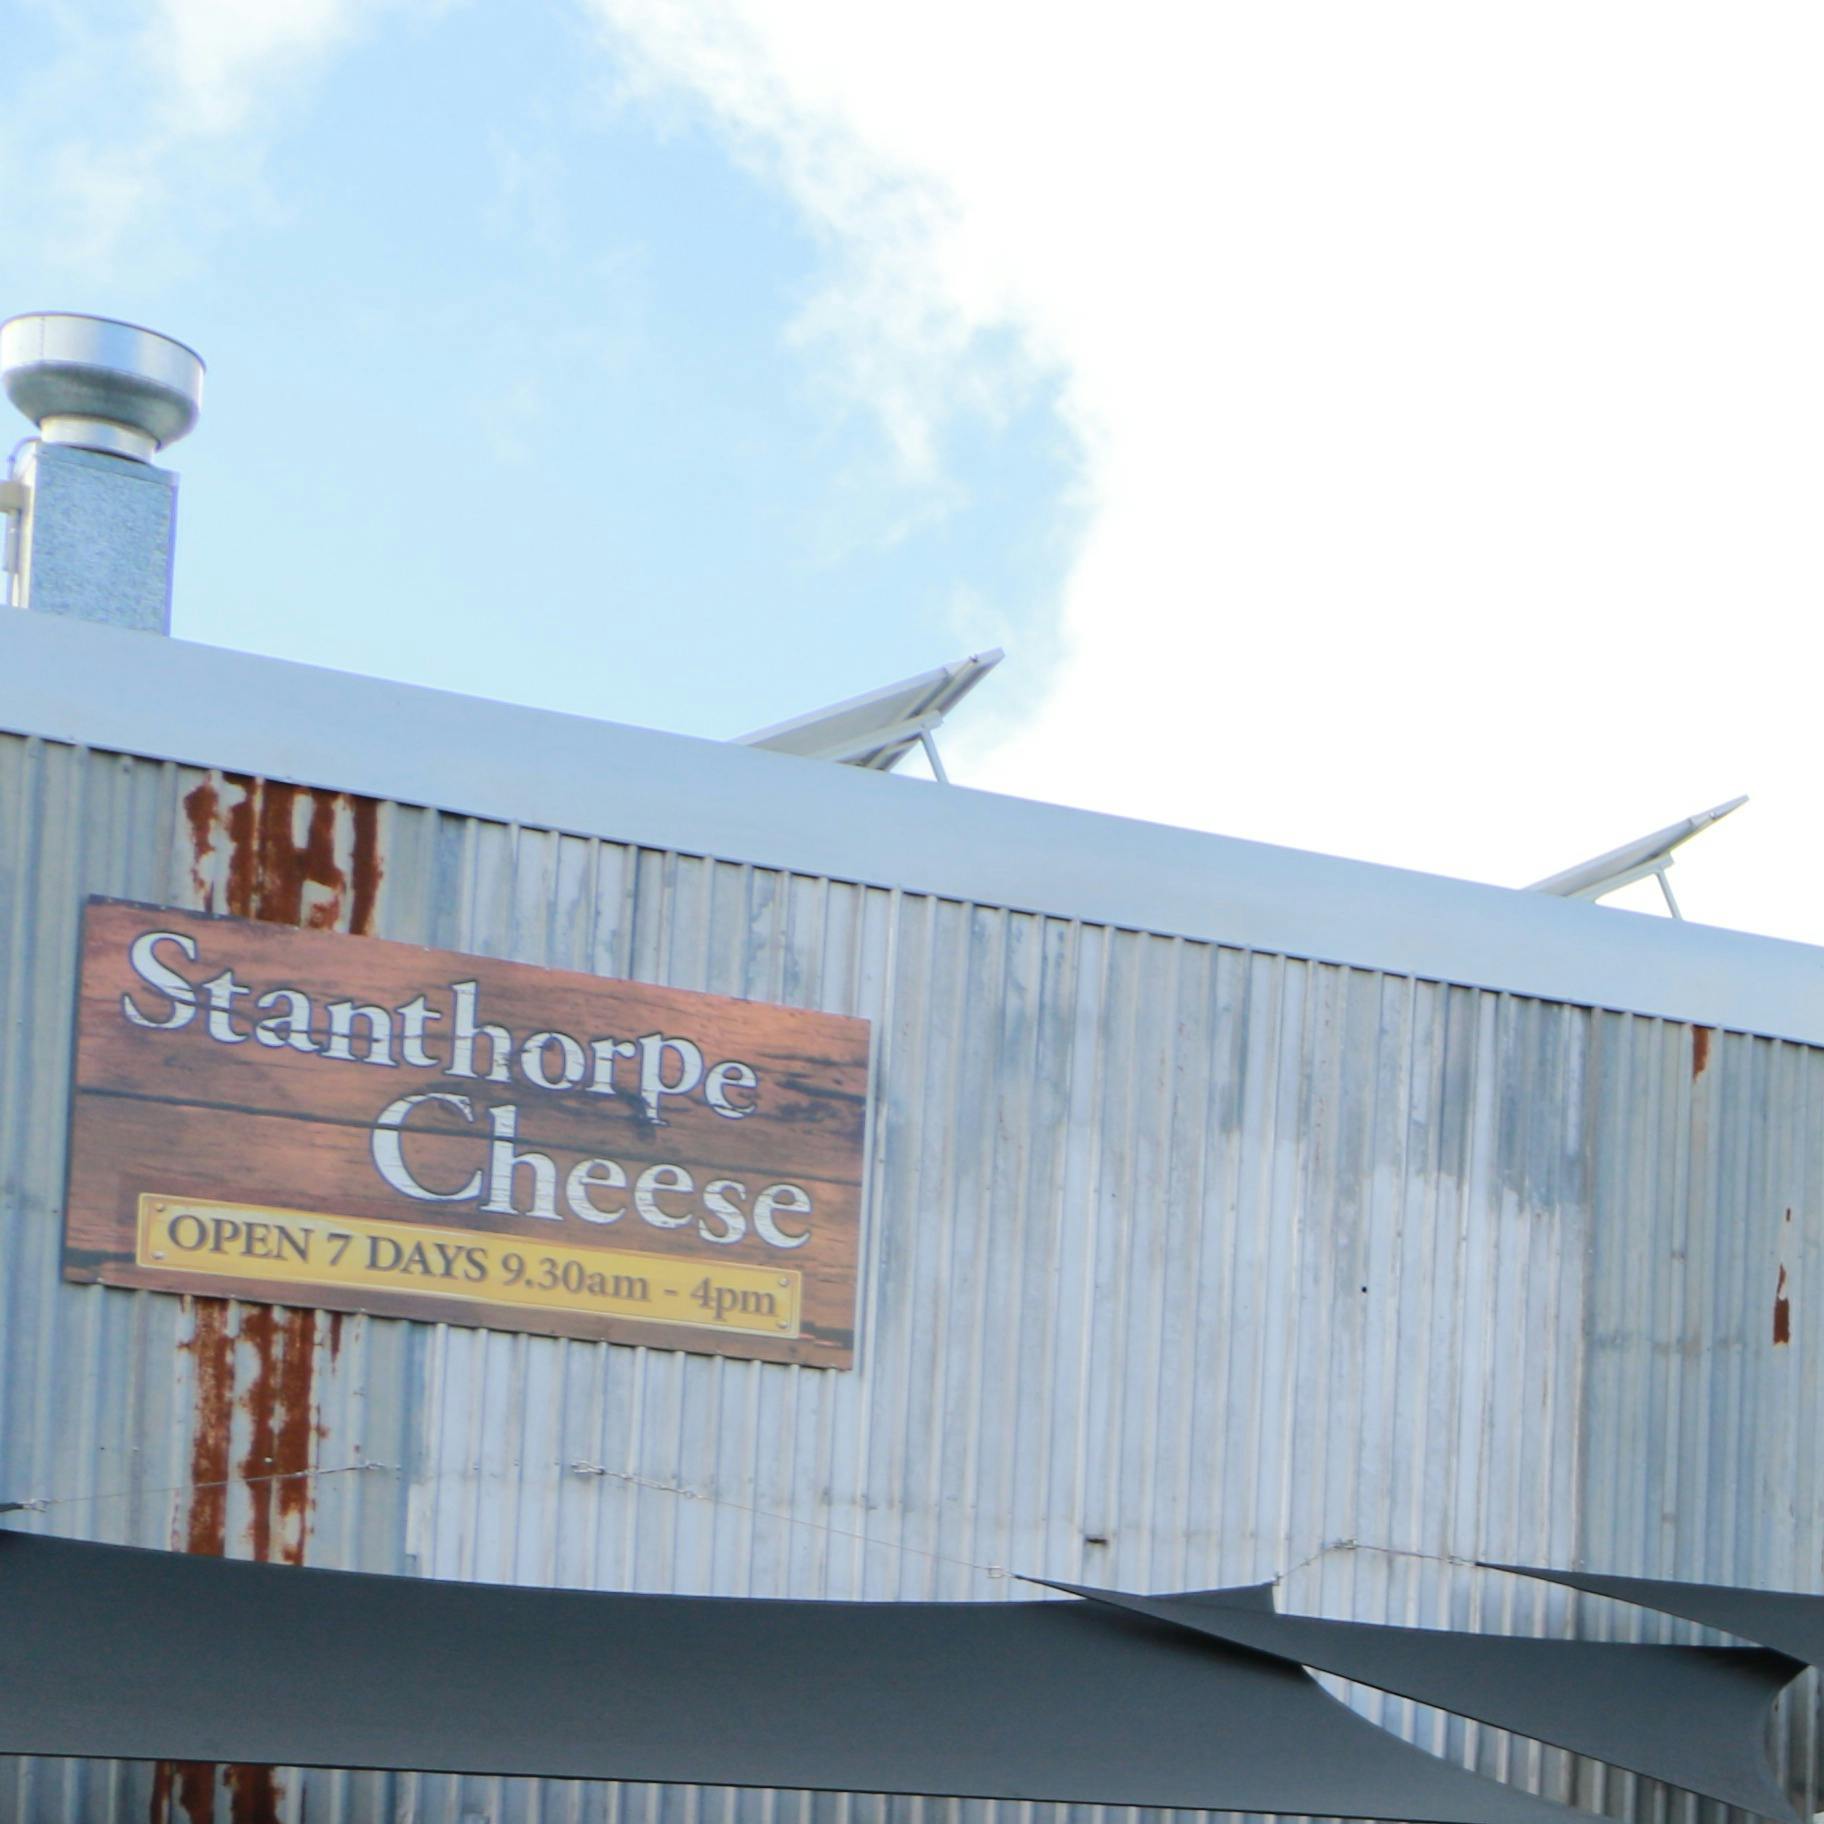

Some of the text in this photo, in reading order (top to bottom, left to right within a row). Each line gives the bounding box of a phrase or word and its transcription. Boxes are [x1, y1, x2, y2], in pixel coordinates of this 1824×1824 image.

[122, 930, 759, 1124] Stanthorpe
[372, 1092, 811, 1248] Cheese
[168, 1214, 311, 1262] OPEN
[328, 1233, 350, 1267] 7
[369, 1237, 487, 1282] DAYS
[502, 1254, 649, 1301] 9.30am
[691, 1285, 777, 1322] 4pm
